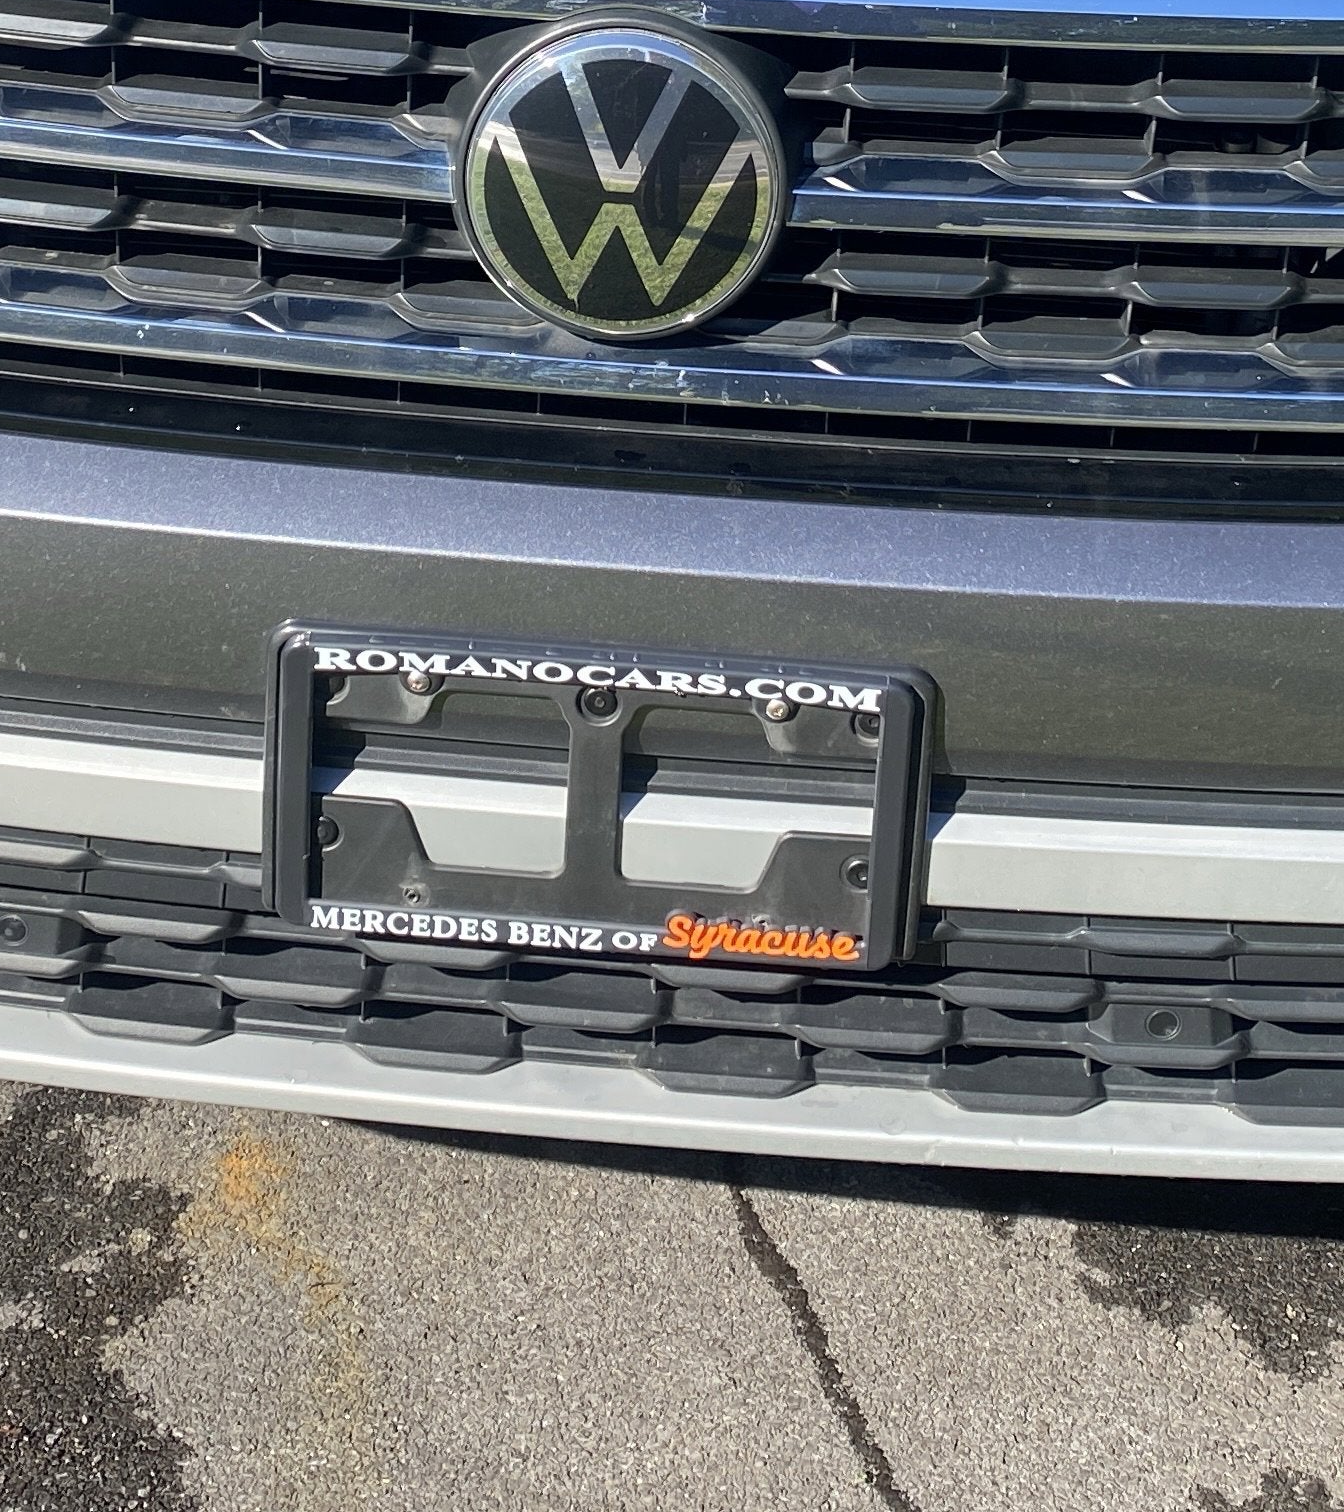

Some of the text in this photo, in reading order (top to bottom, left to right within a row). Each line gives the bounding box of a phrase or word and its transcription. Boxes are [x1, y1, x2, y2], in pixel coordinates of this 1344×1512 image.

[478, 46, 760, 308] VW
[314, 647, 882, 713] ROMANOCARS.COM
[310, 905, 860, 961] MERCEDES BENZ OF Syracuse
